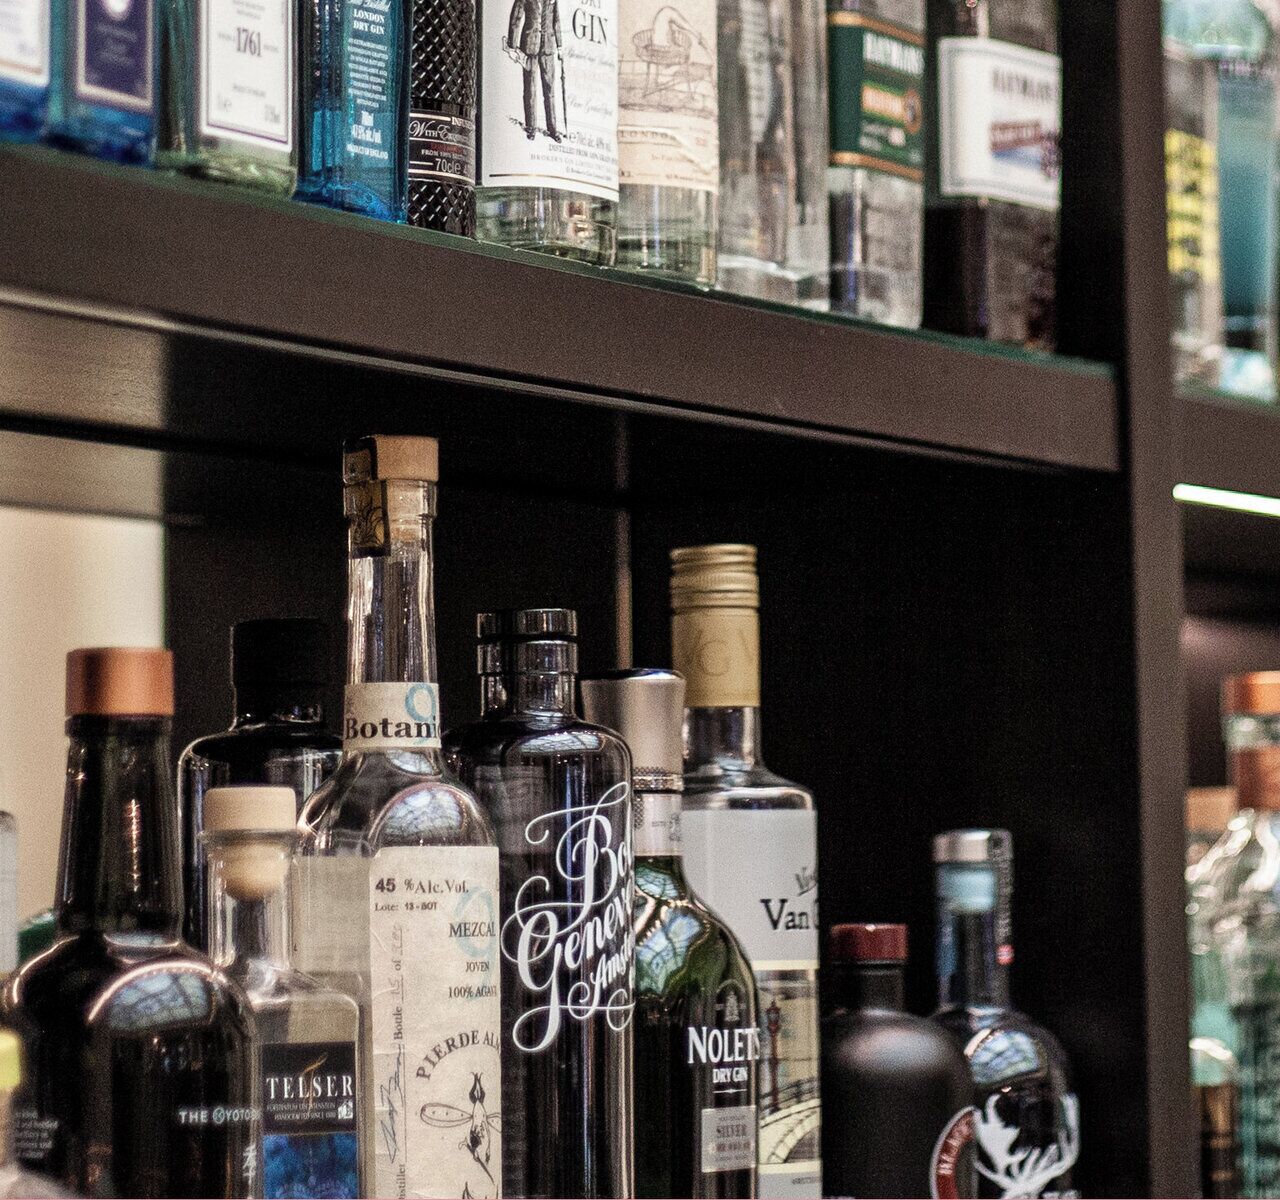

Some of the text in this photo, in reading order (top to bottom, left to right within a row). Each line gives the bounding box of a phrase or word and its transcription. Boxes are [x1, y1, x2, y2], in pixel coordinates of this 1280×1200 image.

[353, 8, 385, 24] LONDON
[353, 20, 385, 35] DRY GIN
[572, 8, 608, 46] GIN
[236, 27, 263, 58] 1761
[345, 715, 440, 740] Botani
[375, 878, 396, 893] 45
[760, 898, 809, 930] Van
[448, 921, 496, 938] MEZCAL
[465, 961, 490, 972] JOVEN
[448, 986, 473, 999] 100%
[393, 1006, 403, 1040] Bottle
[416, 1030, 480, 1081] PIERDE
[713, 1066, 748, 1083] DRY GIN
[266, 1075, 353, 1100] TELSER
[179, 1110, 208, 1124] THE
